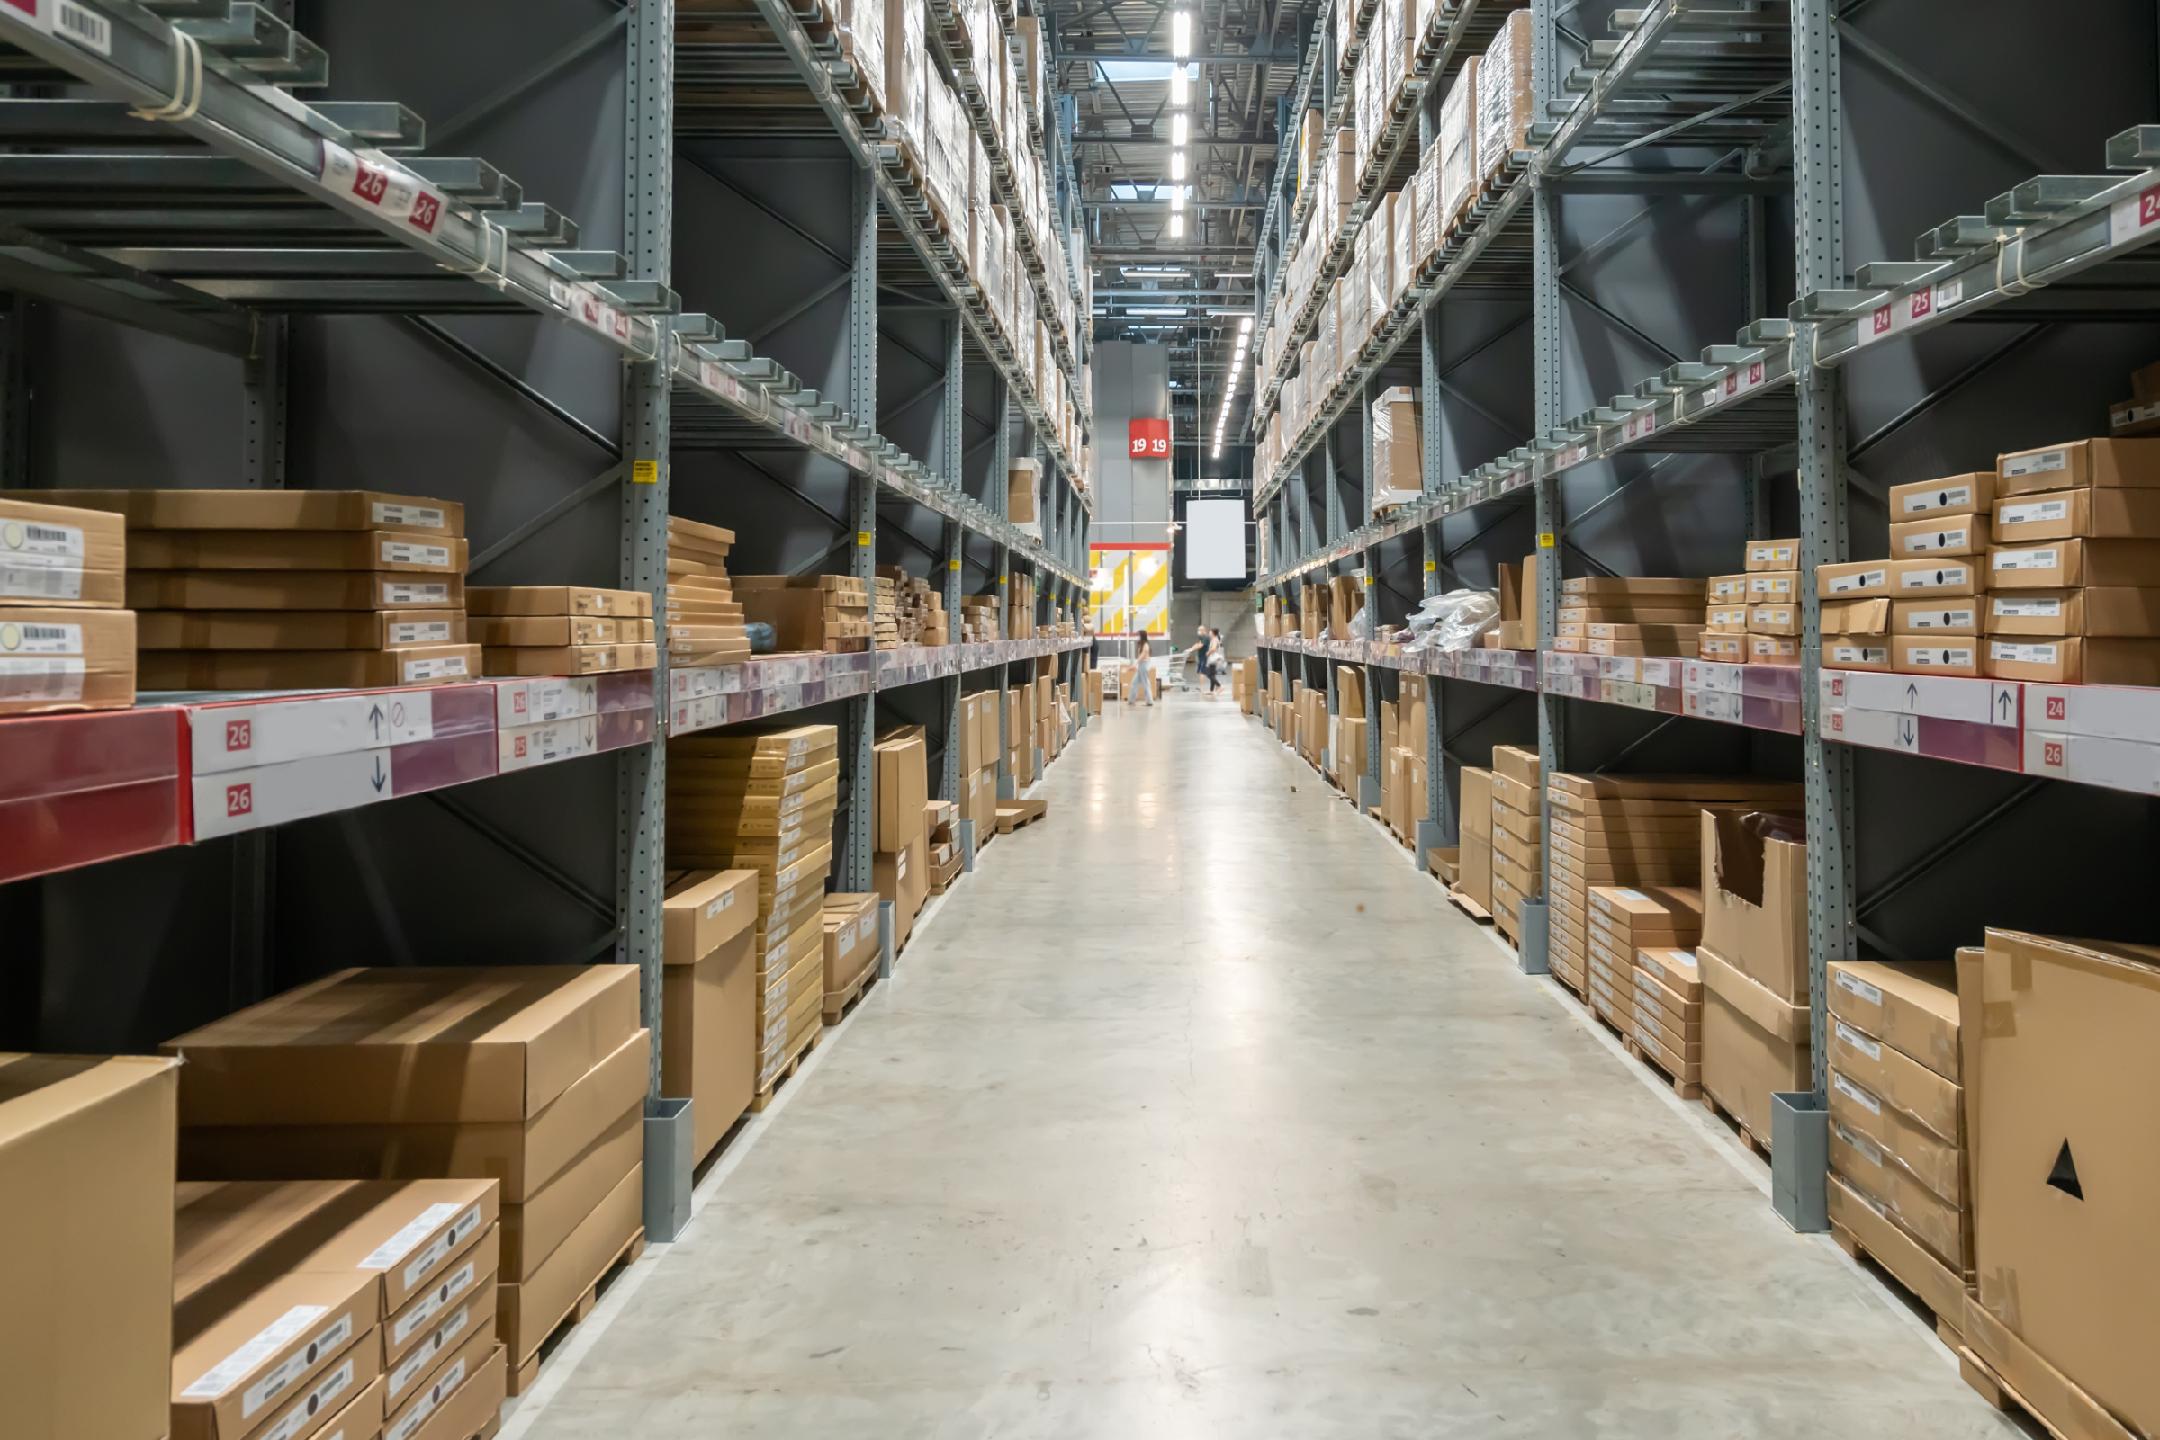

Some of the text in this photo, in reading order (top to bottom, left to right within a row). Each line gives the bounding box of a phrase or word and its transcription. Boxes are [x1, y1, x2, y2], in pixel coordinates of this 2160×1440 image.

[360, 173, 435, 224] 26 26
[1876, 293, 1928, 330] 24 25
[1132, 438, 1147, 453] 19
[1152, 438, 1167, 453] 19
[2048, 700, 2064, 716] 24
[228, 724, 249, 747] 26
[2047, 747, 2061, 763] 26
[228, 788, 250, 811] 26
